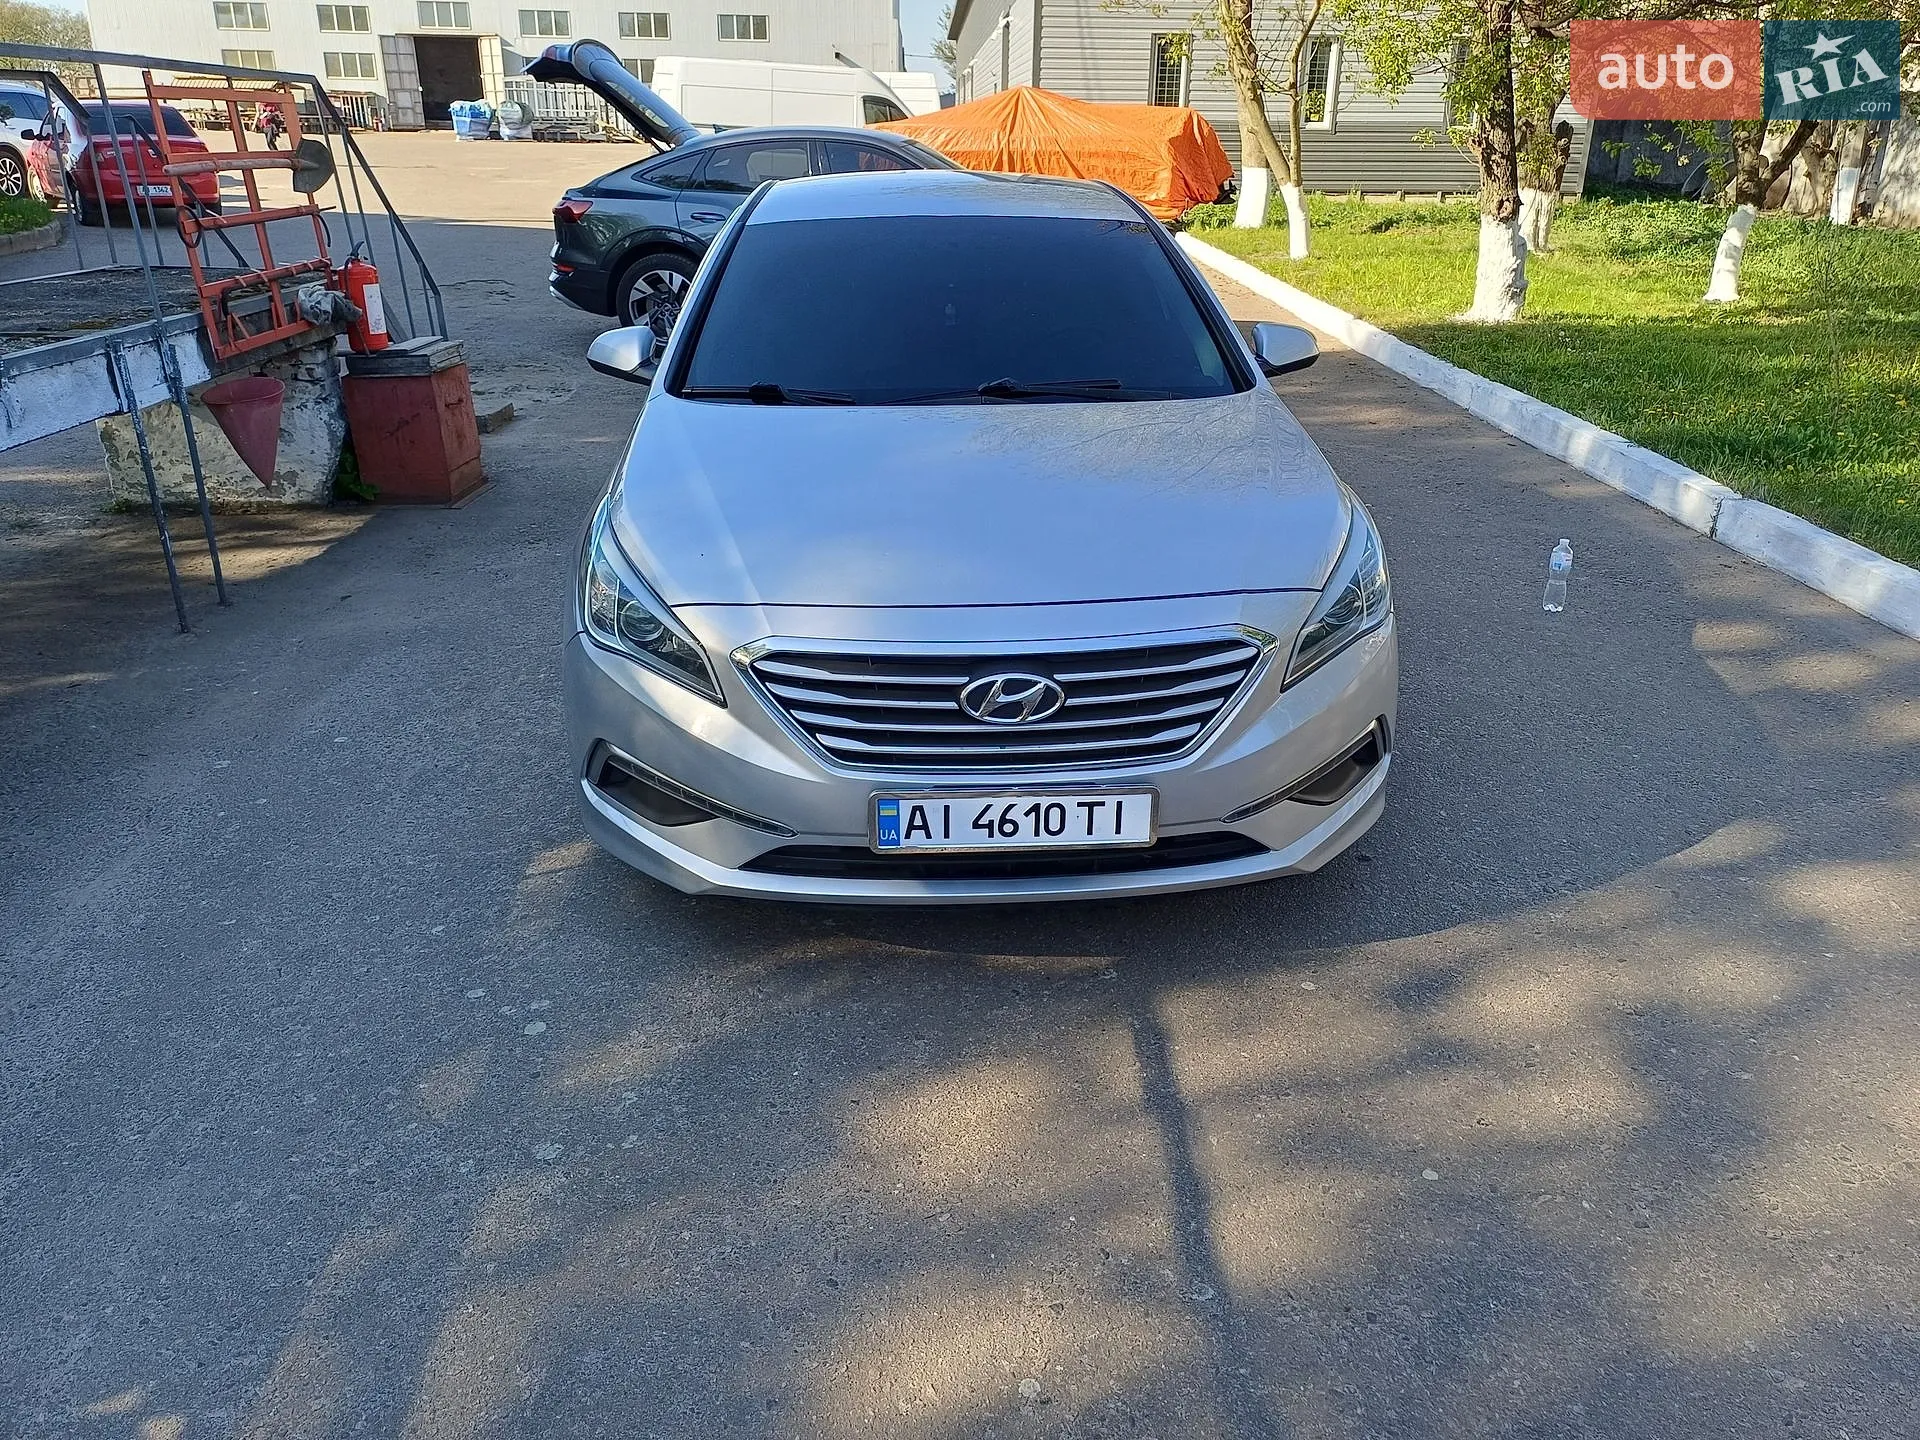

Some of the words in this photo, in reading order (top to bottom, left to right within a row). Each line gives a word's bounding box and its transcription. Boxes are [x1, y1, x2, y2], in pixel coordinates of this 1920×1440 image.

[904, 804, 951, 840] AI
[971, 802, 1067, 838] 4610
[1076, 800, 1124, 836] TI
[880, 831, 898, 841] UA
